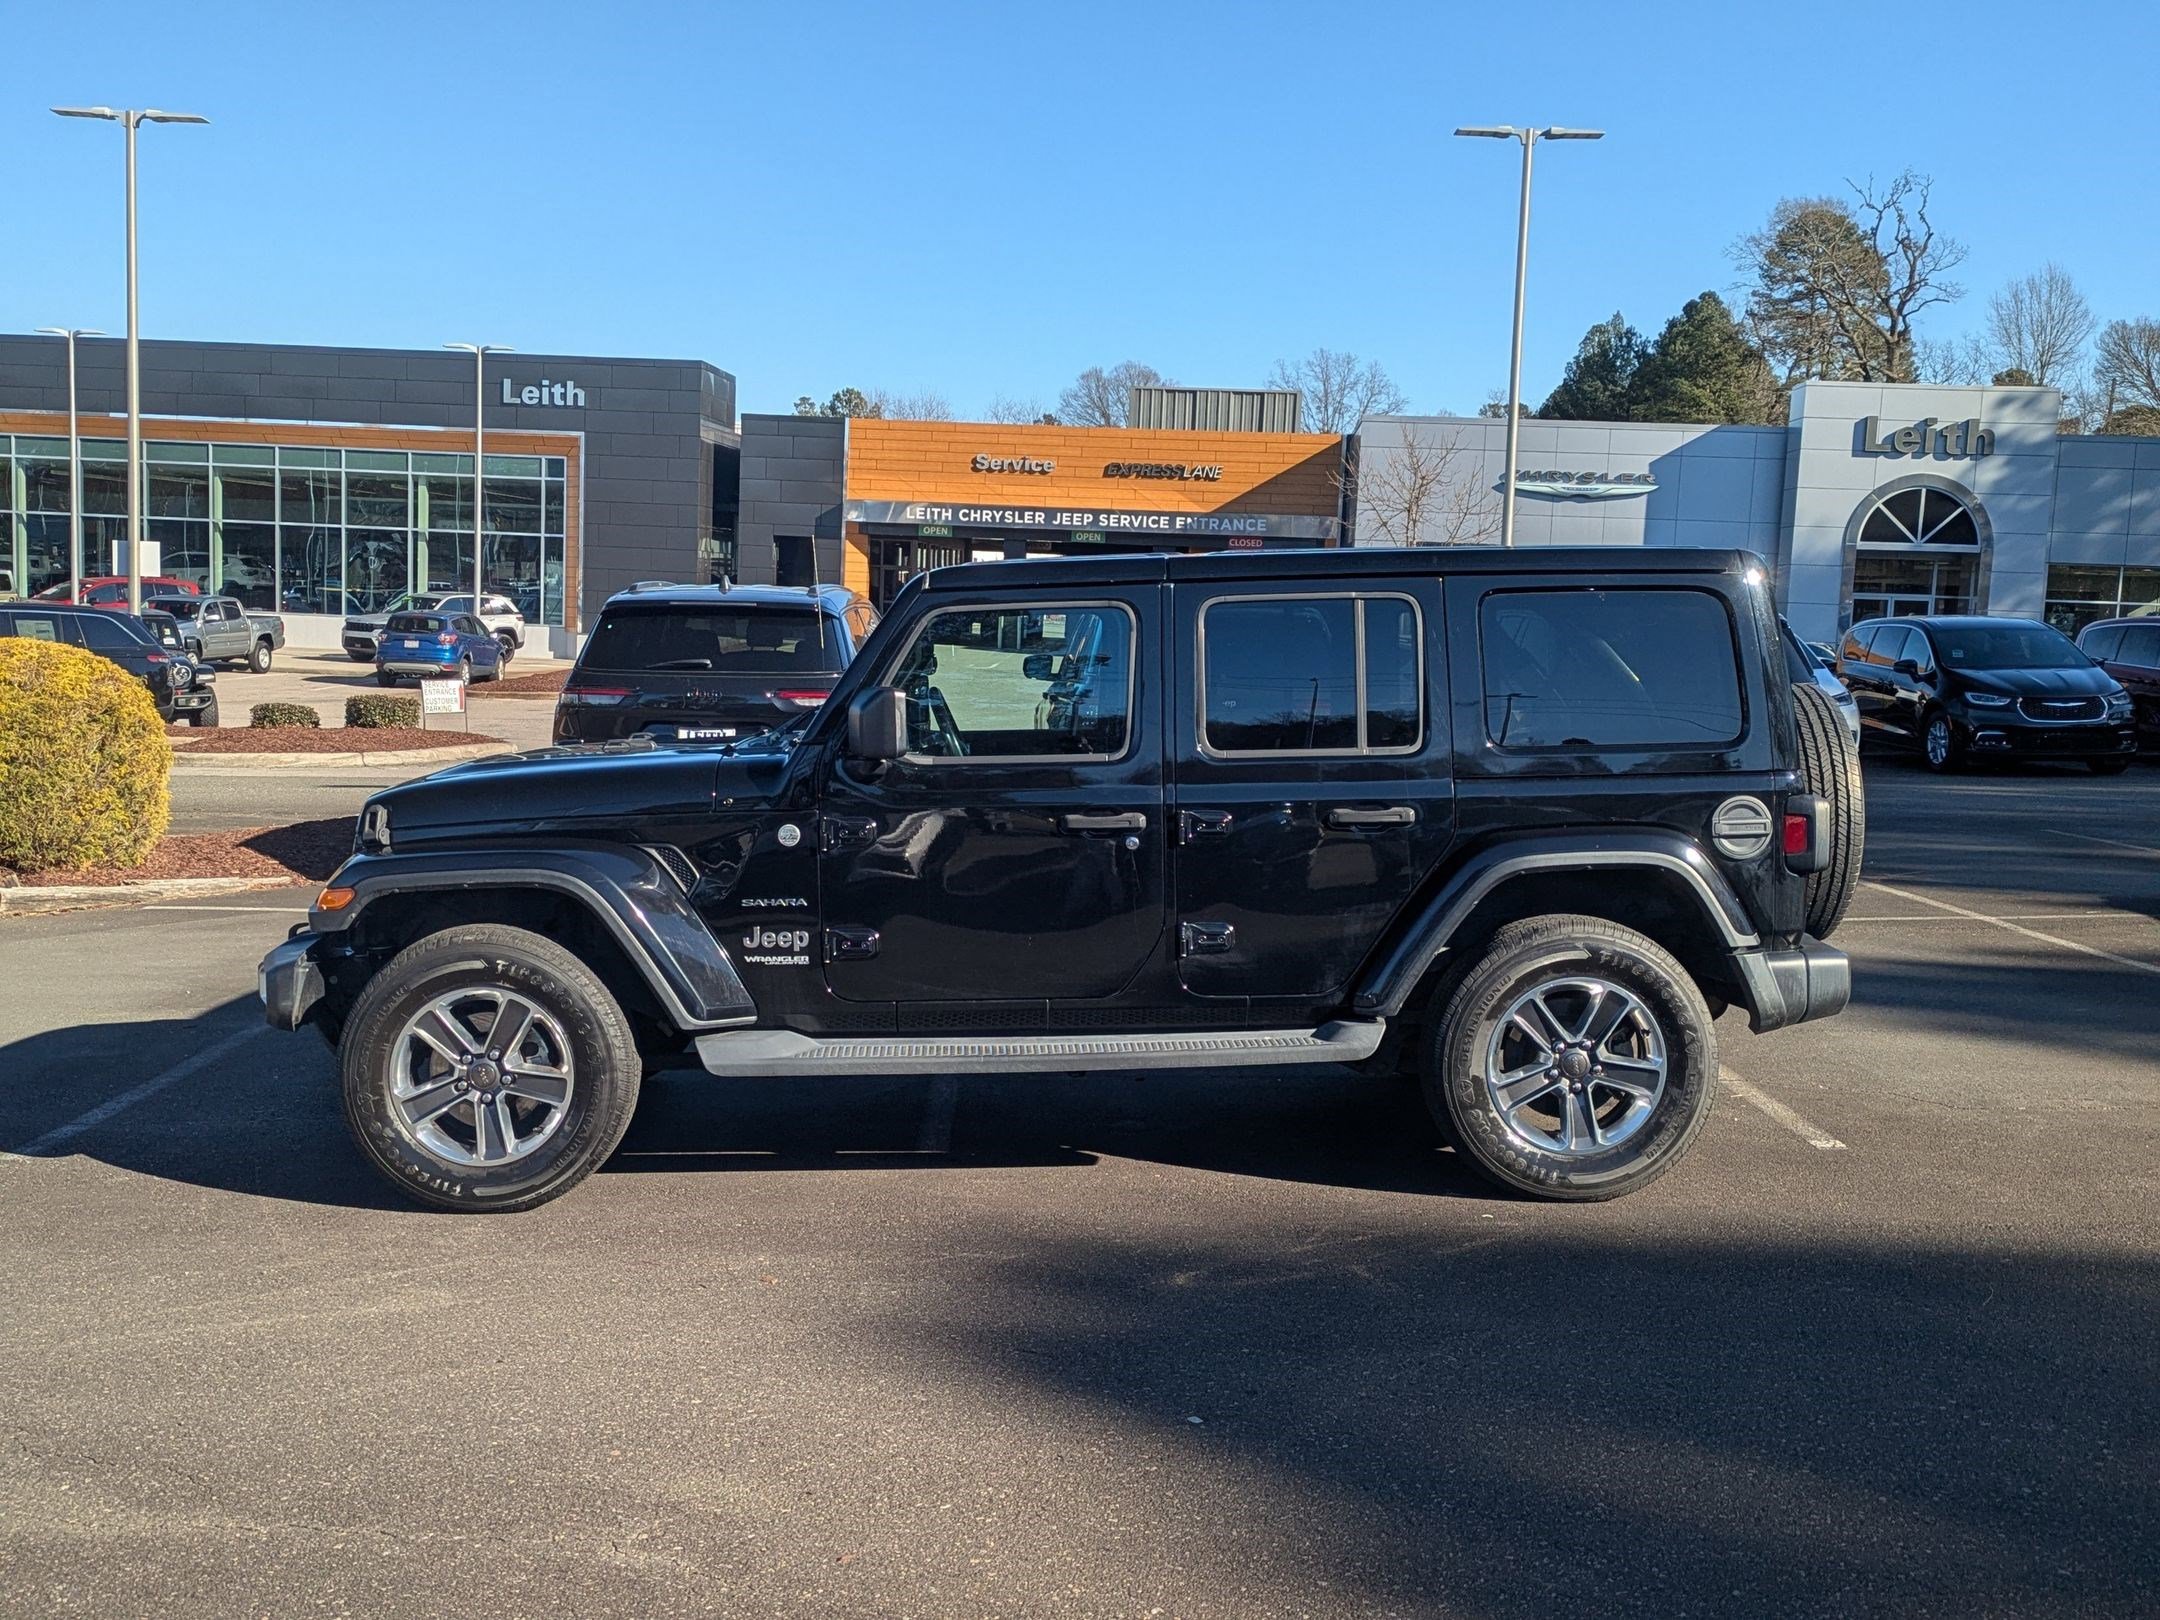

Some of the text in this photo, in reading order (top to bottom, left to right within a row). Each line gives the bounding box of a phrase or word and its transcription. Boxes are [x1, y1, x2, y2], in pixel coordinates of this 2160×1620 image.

[503, 378, 585, 406] Leith
[1864, 415, 1996, 455] Leith
[974, 453, 1056, 473] Service
[906, 508, 1267, 532] LEITH CHRYSLER JEEP SERVICE ENTRANCE
[923, 526, 948, 535] OPEN
[1076, 532, 1101, 541] OPEN
[1229, 538, 1263, 547] CLOSED
[424, 688, 457, 696] ENTRANCE
[425, 697, 459, 705] CUSTOMER
[741, 898, 808, 907] SAHARA
[743, 926, 809, 951] Jeep
